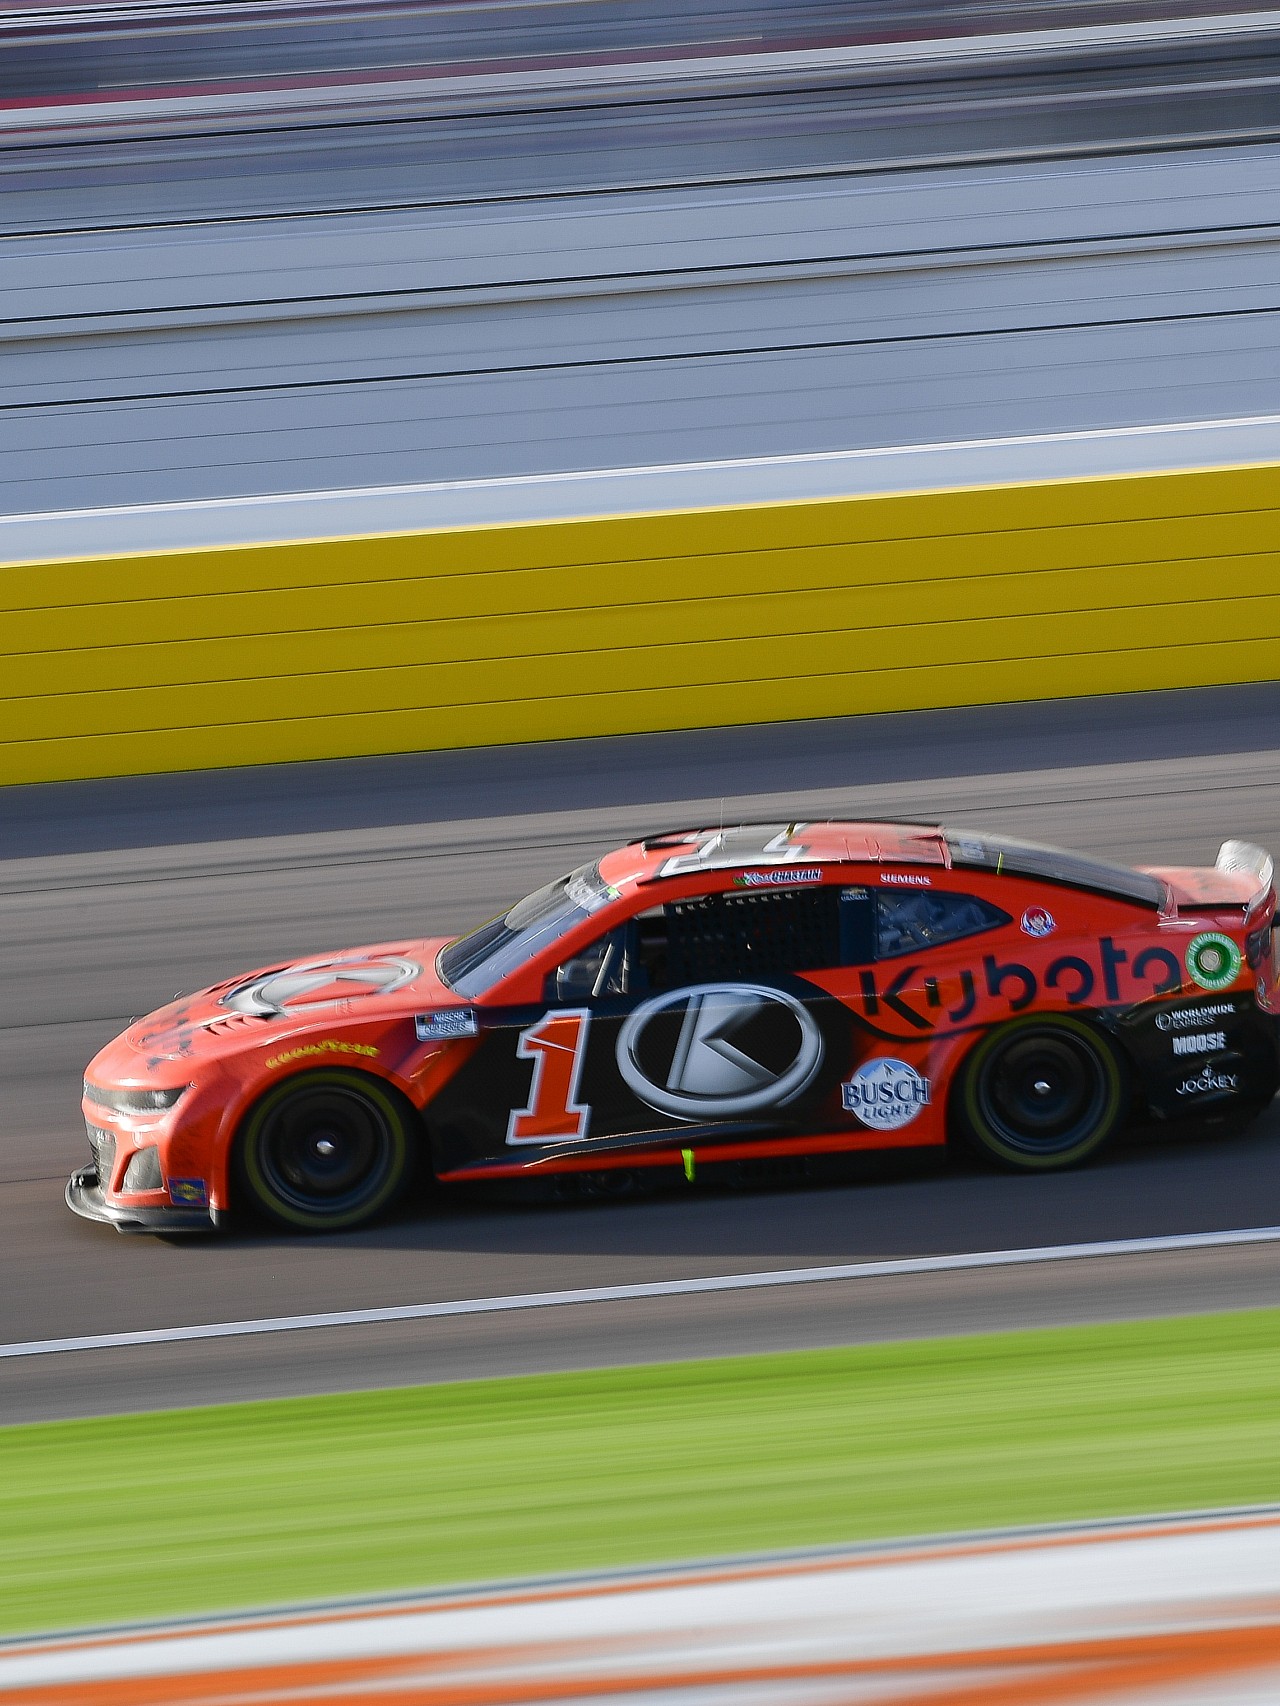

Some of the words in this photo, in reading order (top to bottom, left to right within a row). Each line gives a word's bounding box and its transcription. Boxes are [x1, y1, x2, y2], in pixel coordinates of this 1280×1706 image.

[880, 873, 933, 886] SIEMENS
[1171, 1003, 1236, 1020] WORLDWIDE
[1173, 1015, 1215, 1029] EXPRESS
[1172, 1031, 1226, 1055] MOOSE
[505, 1007, 592, 1146] 1
[1175, 1074, 1238, 1094] JOCKEY
[842, 1079, 931, 1109] BUSCH
[863, 1104, 914, 1119] LIGHT
